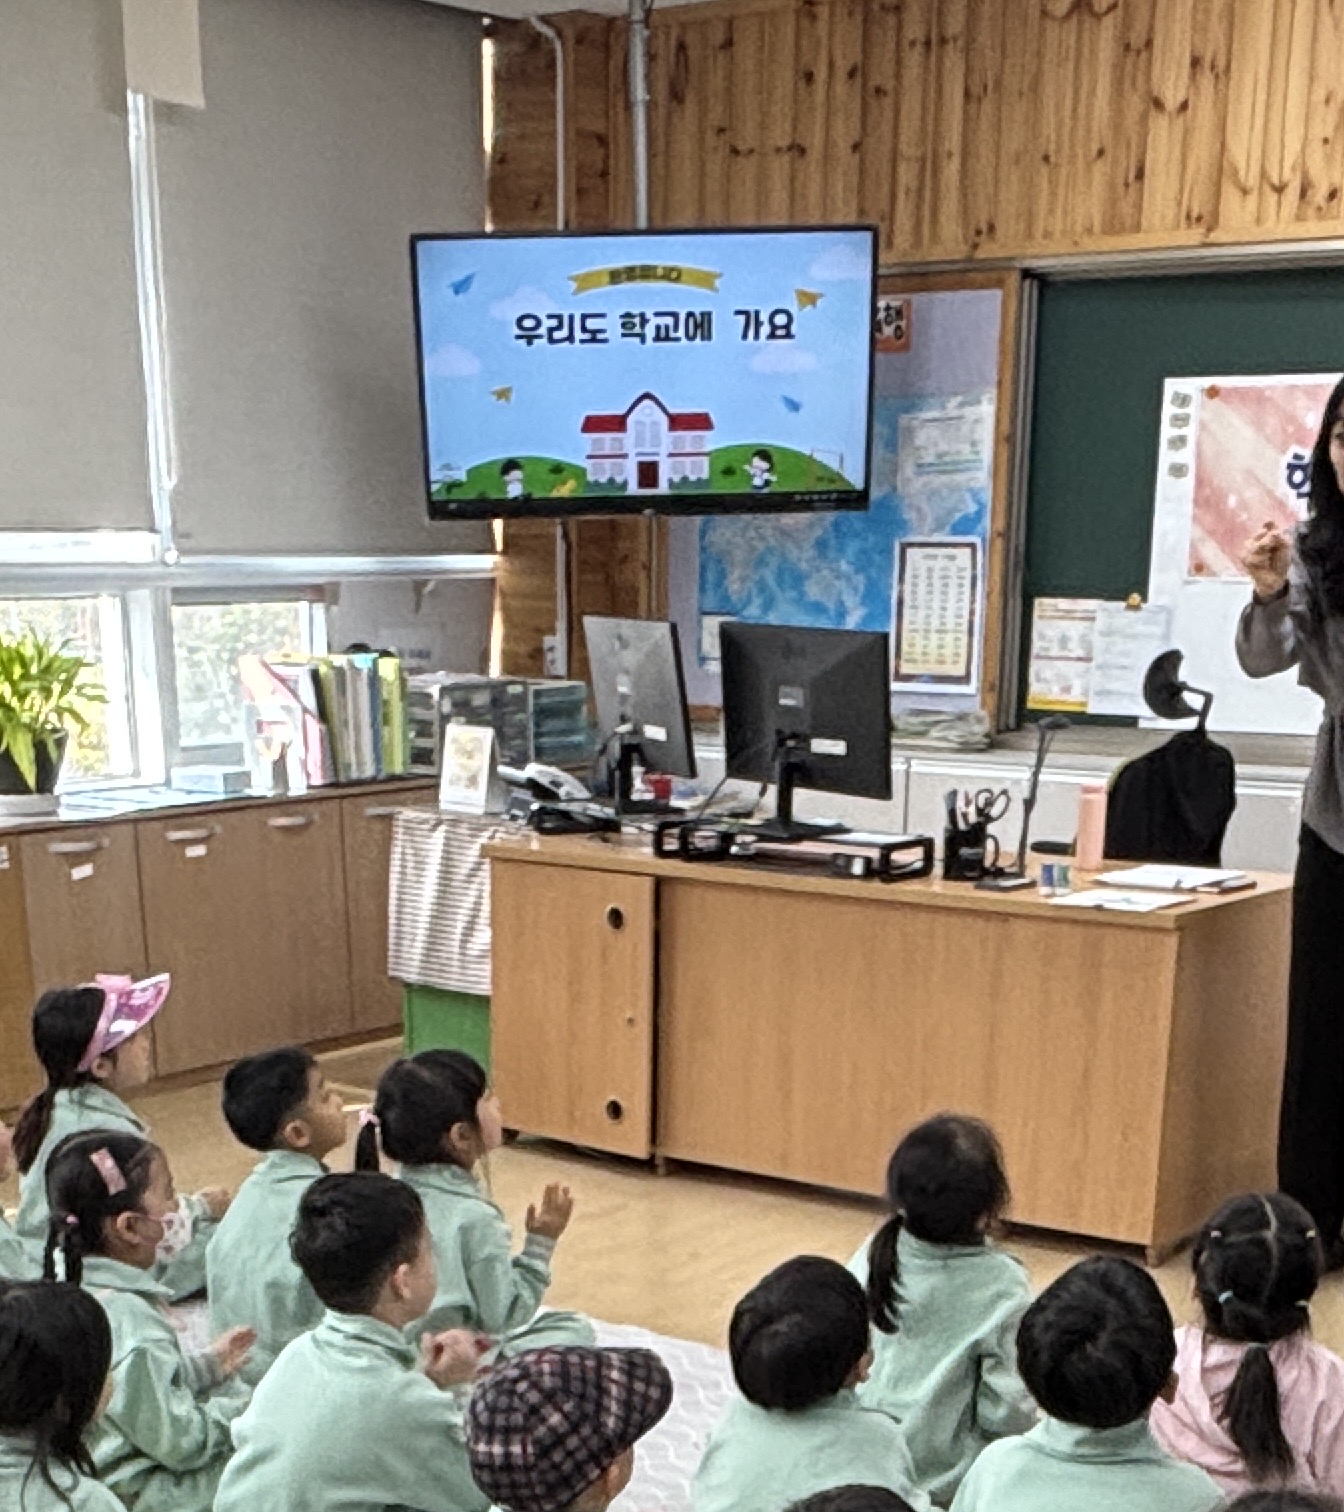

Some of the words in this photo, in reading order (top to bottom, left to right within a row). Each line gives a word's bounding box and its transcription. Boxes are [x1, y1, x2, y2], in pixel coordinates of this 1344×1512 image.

[514, 312, 609, 346] 우리도
[619, 310, 713, 345] 학교에
[733, 308, 796, 341] 가요
